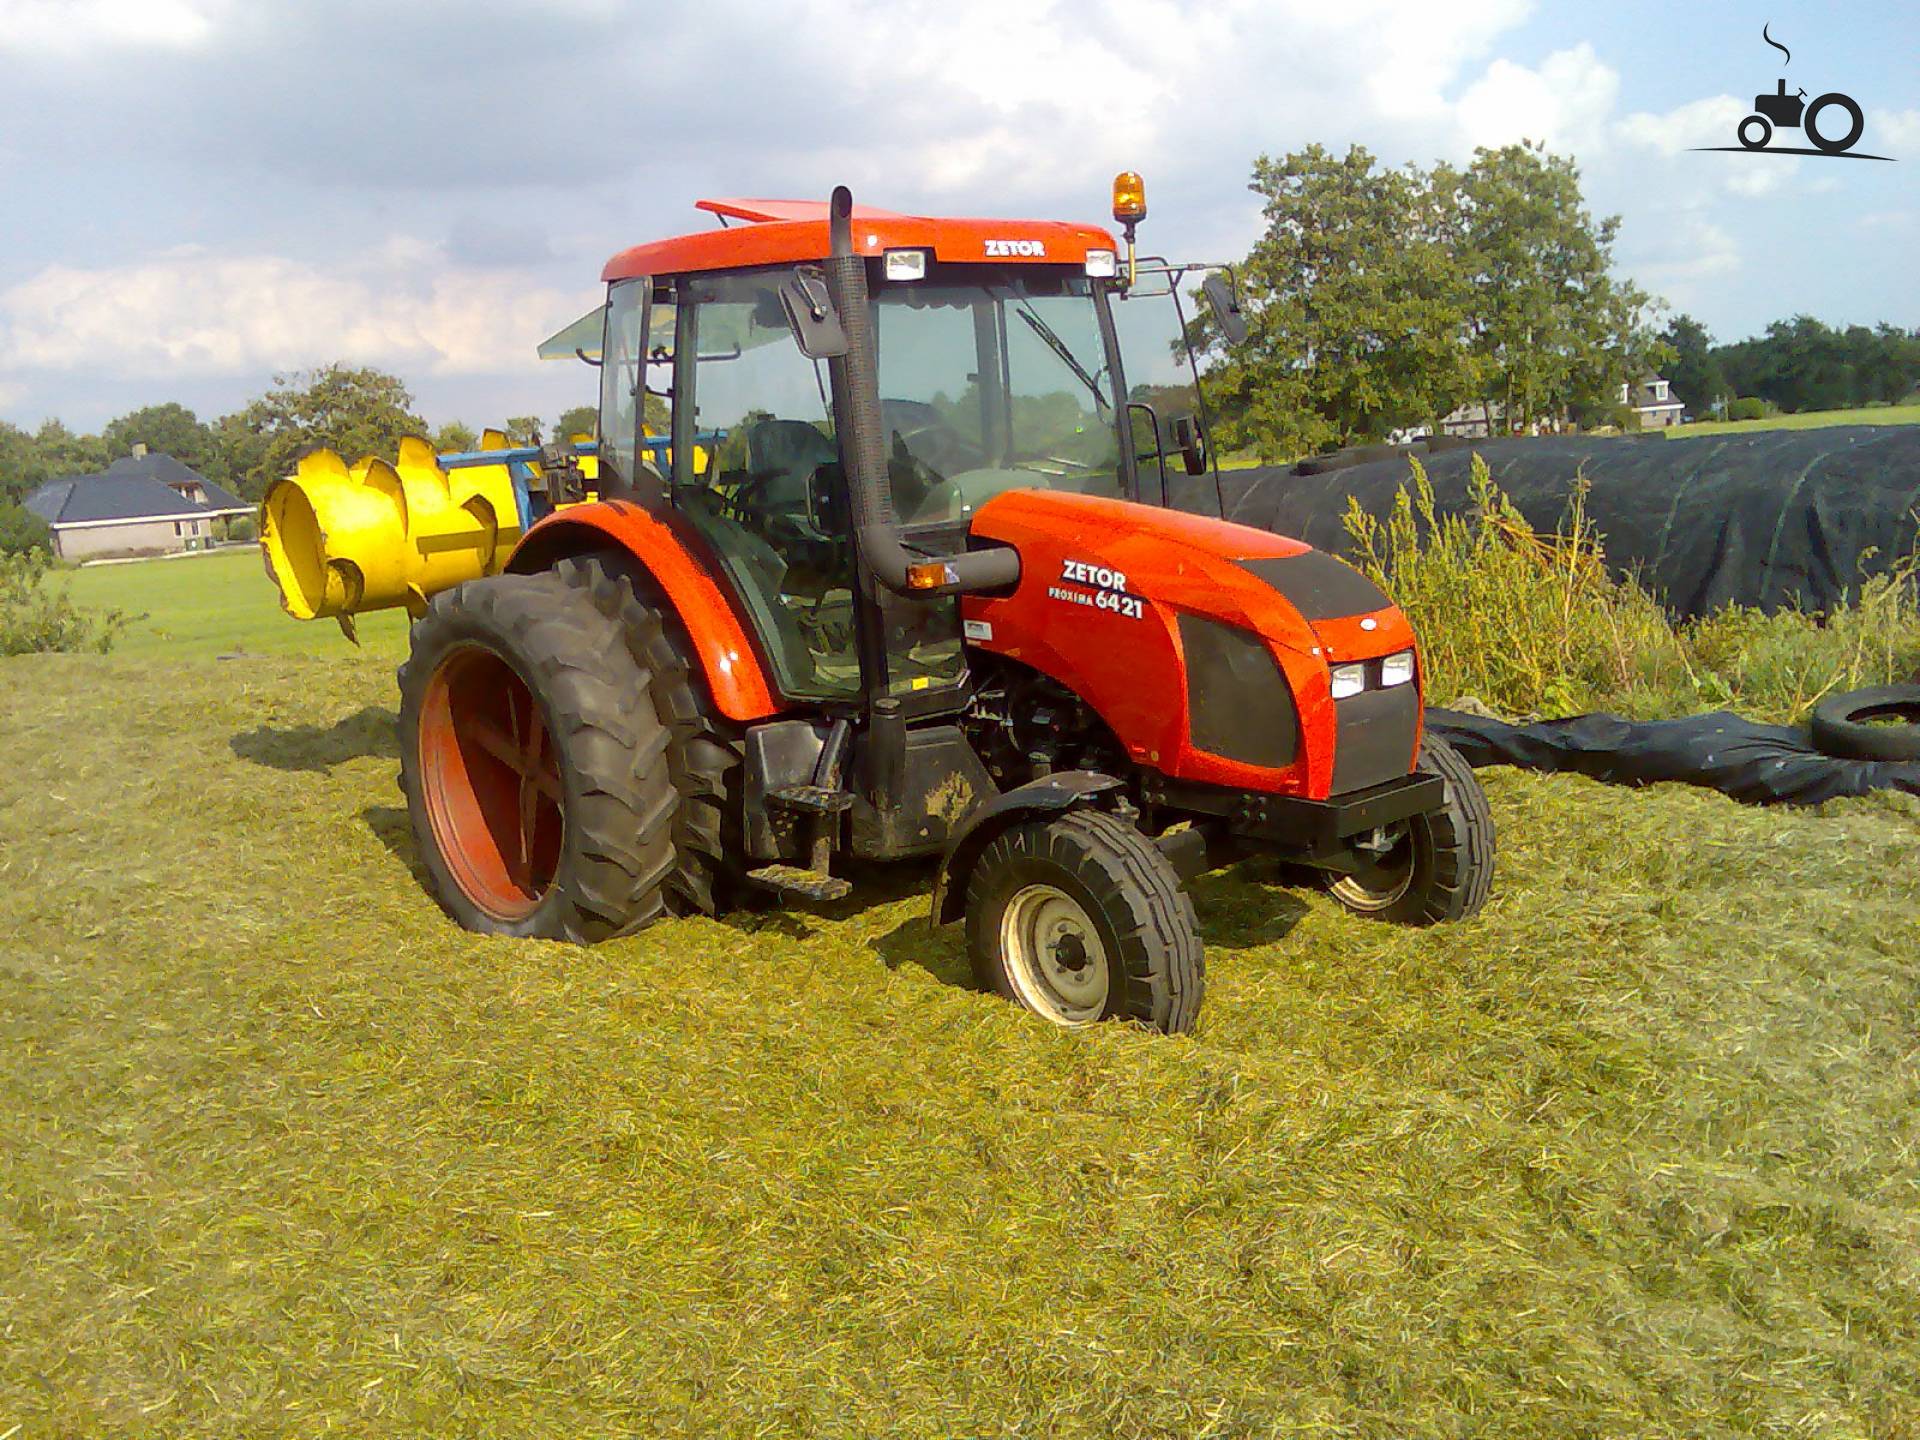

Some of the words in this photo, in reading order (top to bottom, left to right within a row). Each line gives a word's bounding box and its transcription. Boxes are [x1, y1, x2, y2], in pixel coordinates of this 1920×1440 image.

[984, 240, 1045, 257] ZETOR
[1062, 560, 1126, 592] ZETOR
[1048, 587, 1094, 607] PROXIMA
[1095, 591, 1143, 619] 6421
